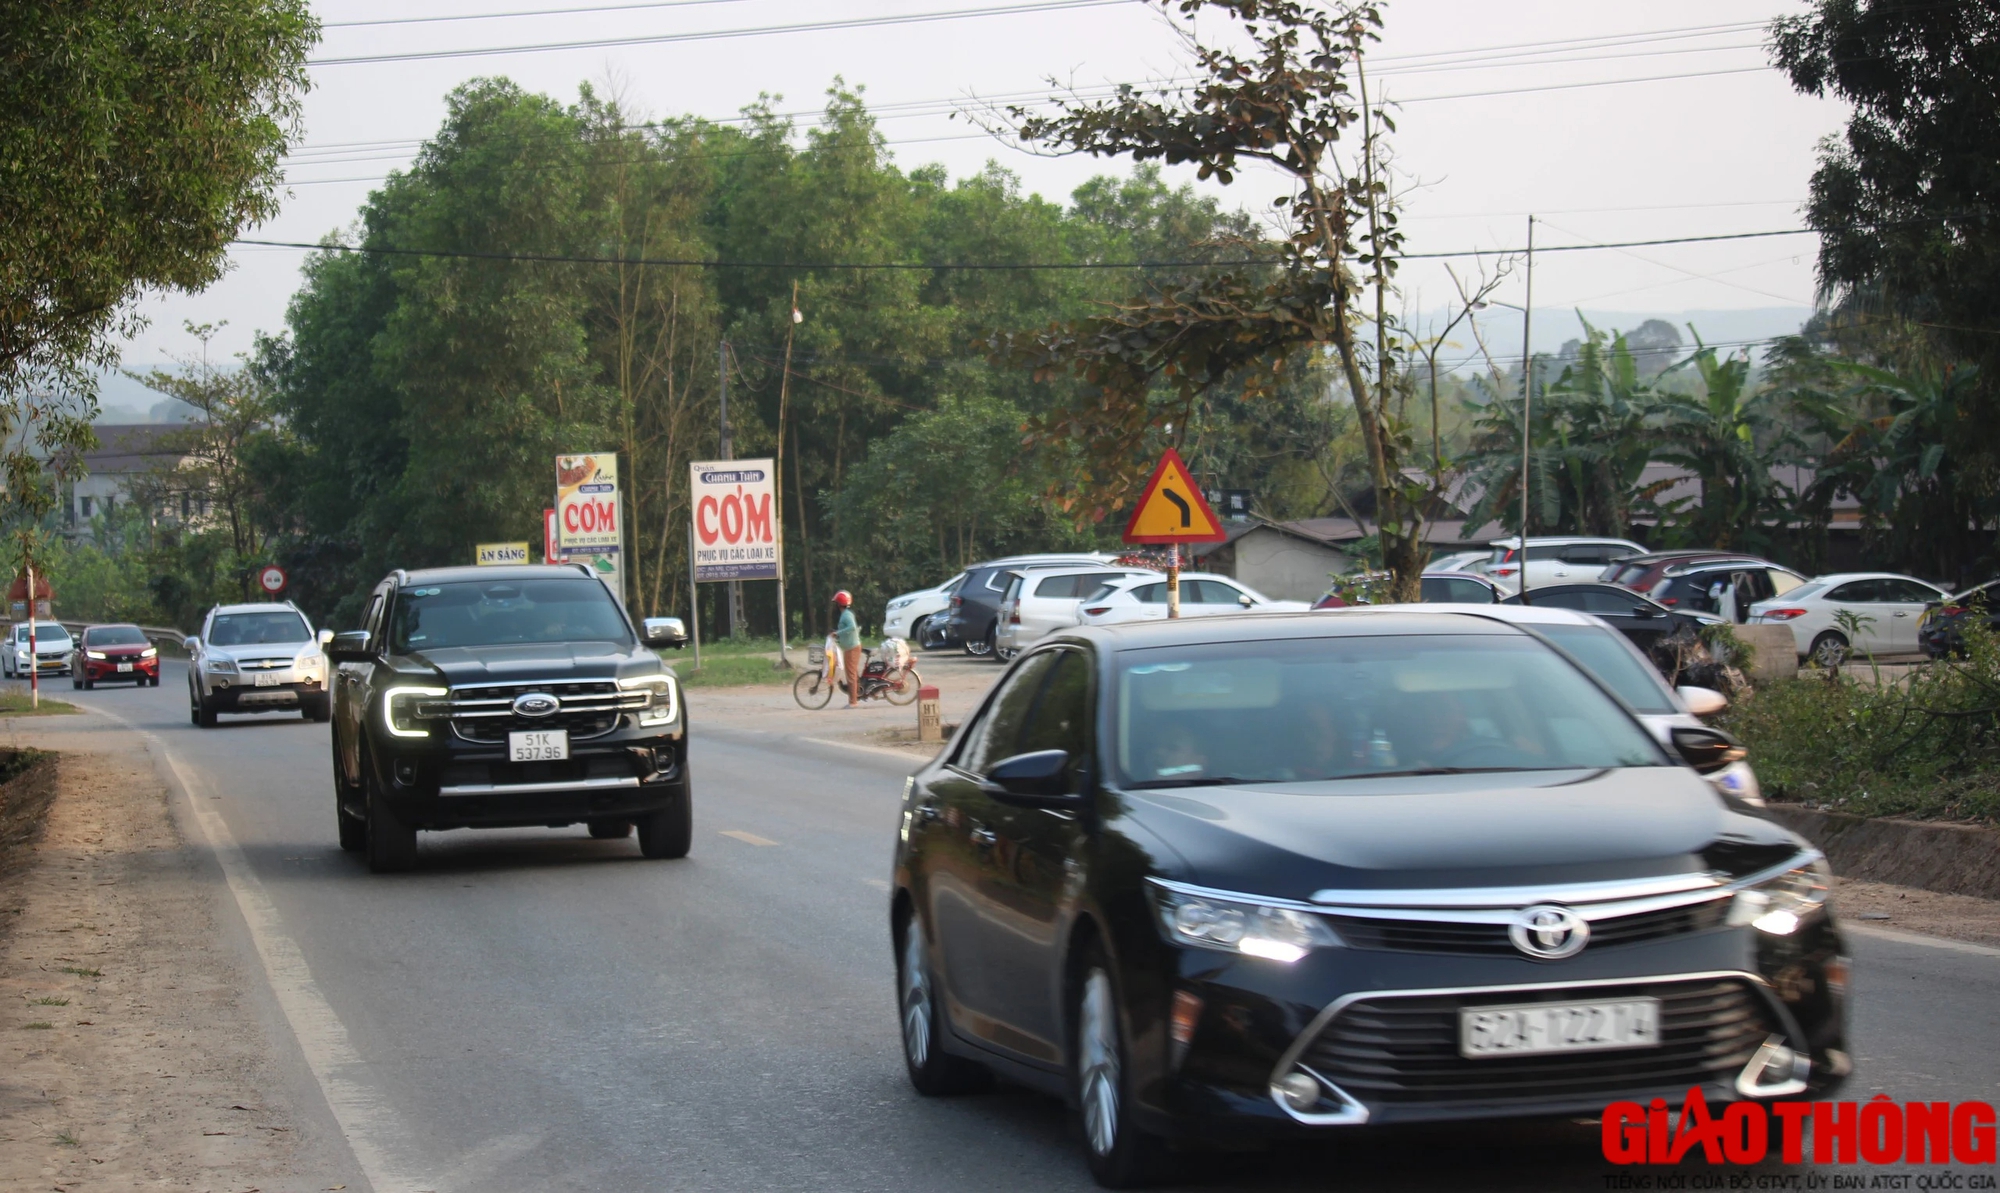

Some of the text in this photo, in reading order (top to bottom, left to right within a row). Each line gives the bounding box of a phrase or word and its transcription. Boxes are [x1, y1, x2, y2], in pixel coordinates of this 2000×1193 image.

[564, 497, 616, 534] CƠM
[696, 484, 773, 546] CƠM
[480, 547, 525, 561] ĂN SÁNG
[697, 547, 774, 564] PHỤC VỤ CÁC LOẠI XE
[923, 703, 936, 715] H1
[525, 733, 549, 746] 51K
[516, 747, 561, 760] 537.96
